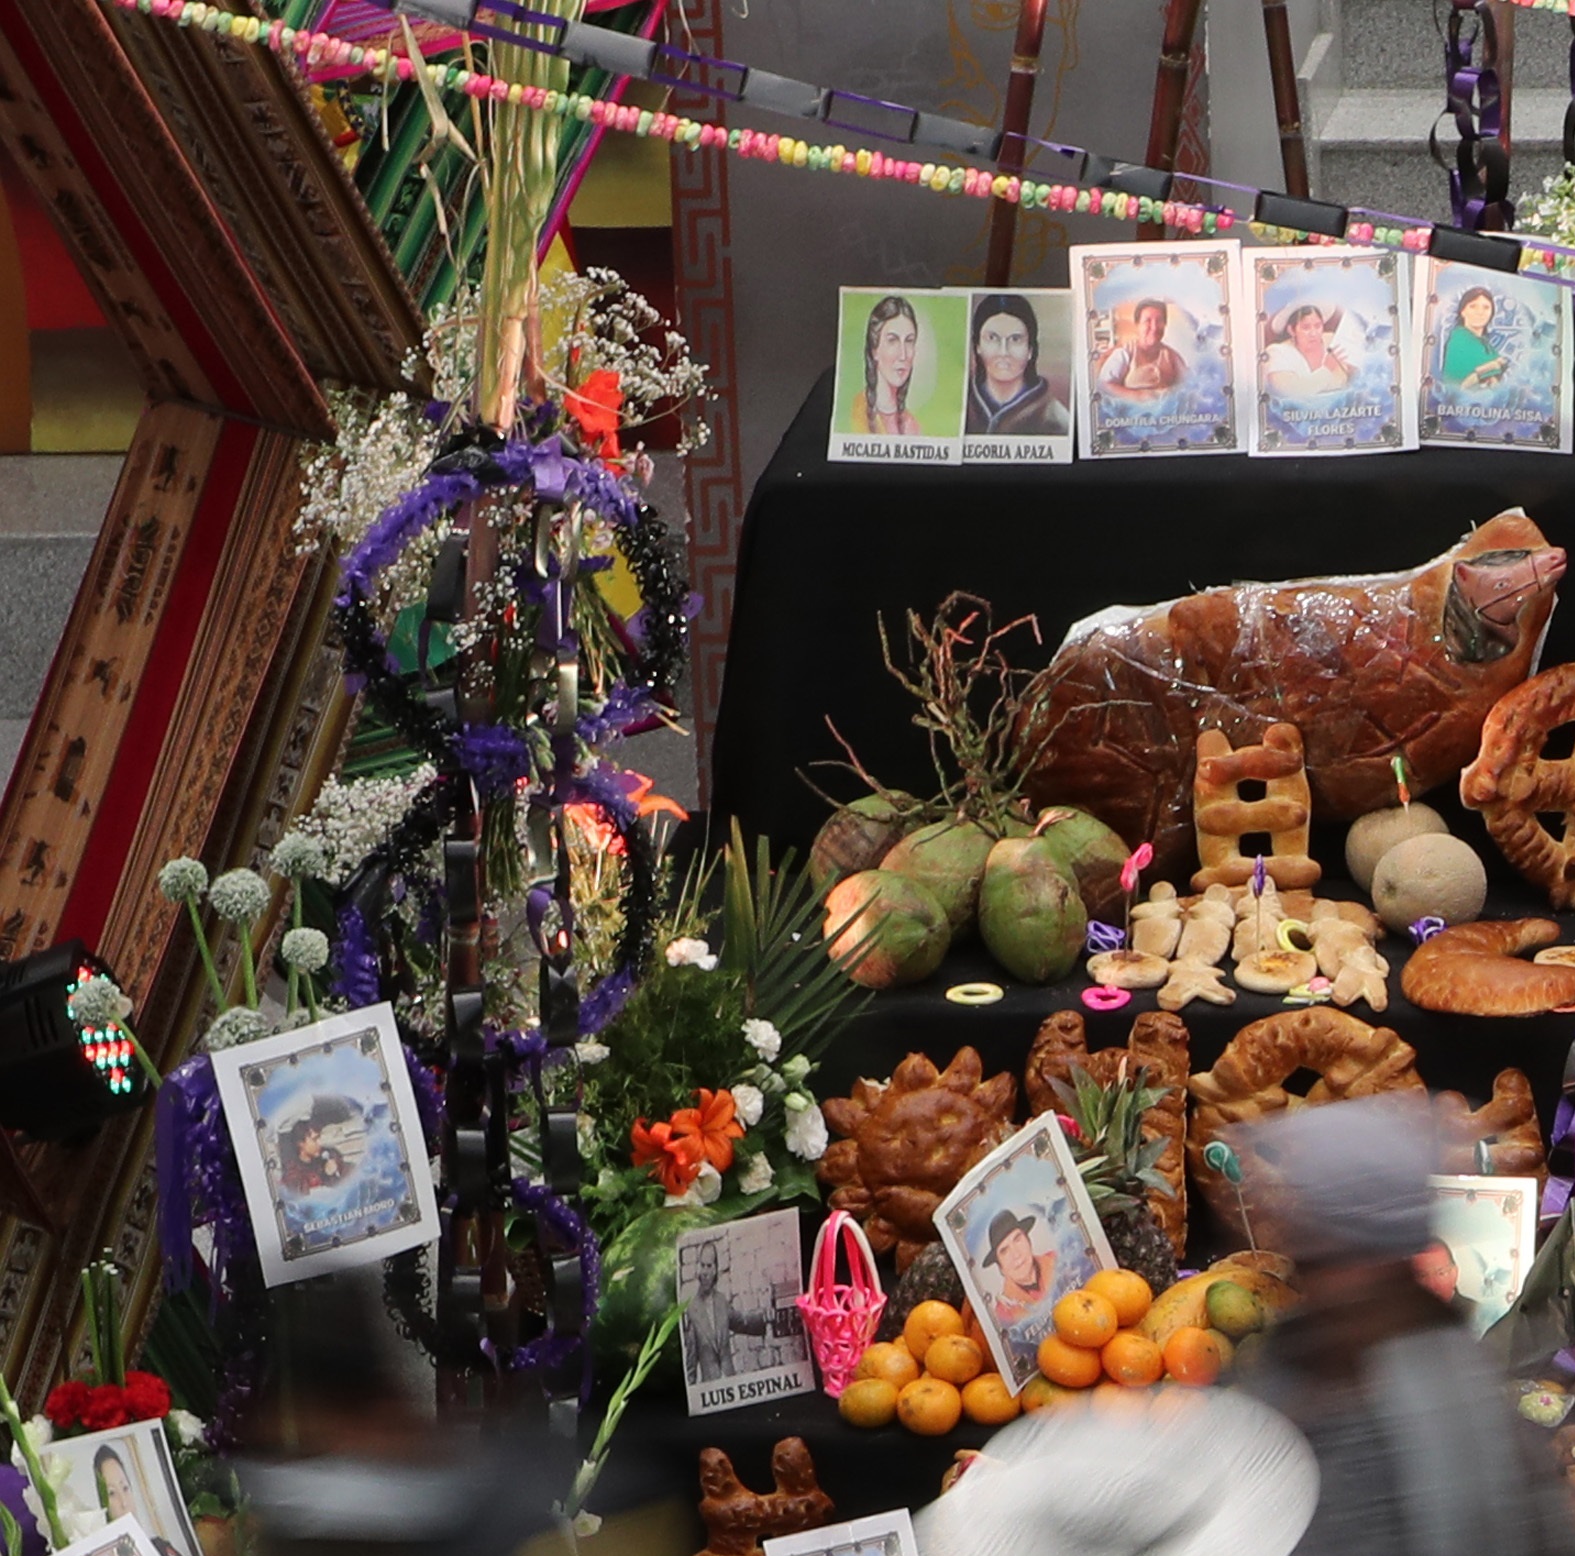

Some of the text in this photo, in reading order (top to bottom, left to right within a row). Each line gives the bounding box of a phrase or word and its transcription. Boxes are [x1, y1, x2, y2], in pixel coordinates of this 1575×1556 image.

[1105, 413, 1220, 427] DOMITILA CHUNGARA
[1283, 405, 1382, 422] SILVIA LAZARTE
[1437, 404, 1543, 421] BARTOLINA SISA
[1308, 423, 1354, 435] FLORES
[841, 442, 950, 460] MICAELA BASTIDAS
[962, 444, 1054, 460] REGORIA APAZA
[363, 1198, 395, 1216] MORO
[700, 1373, 803, 1408] LUIS ESPINAL
